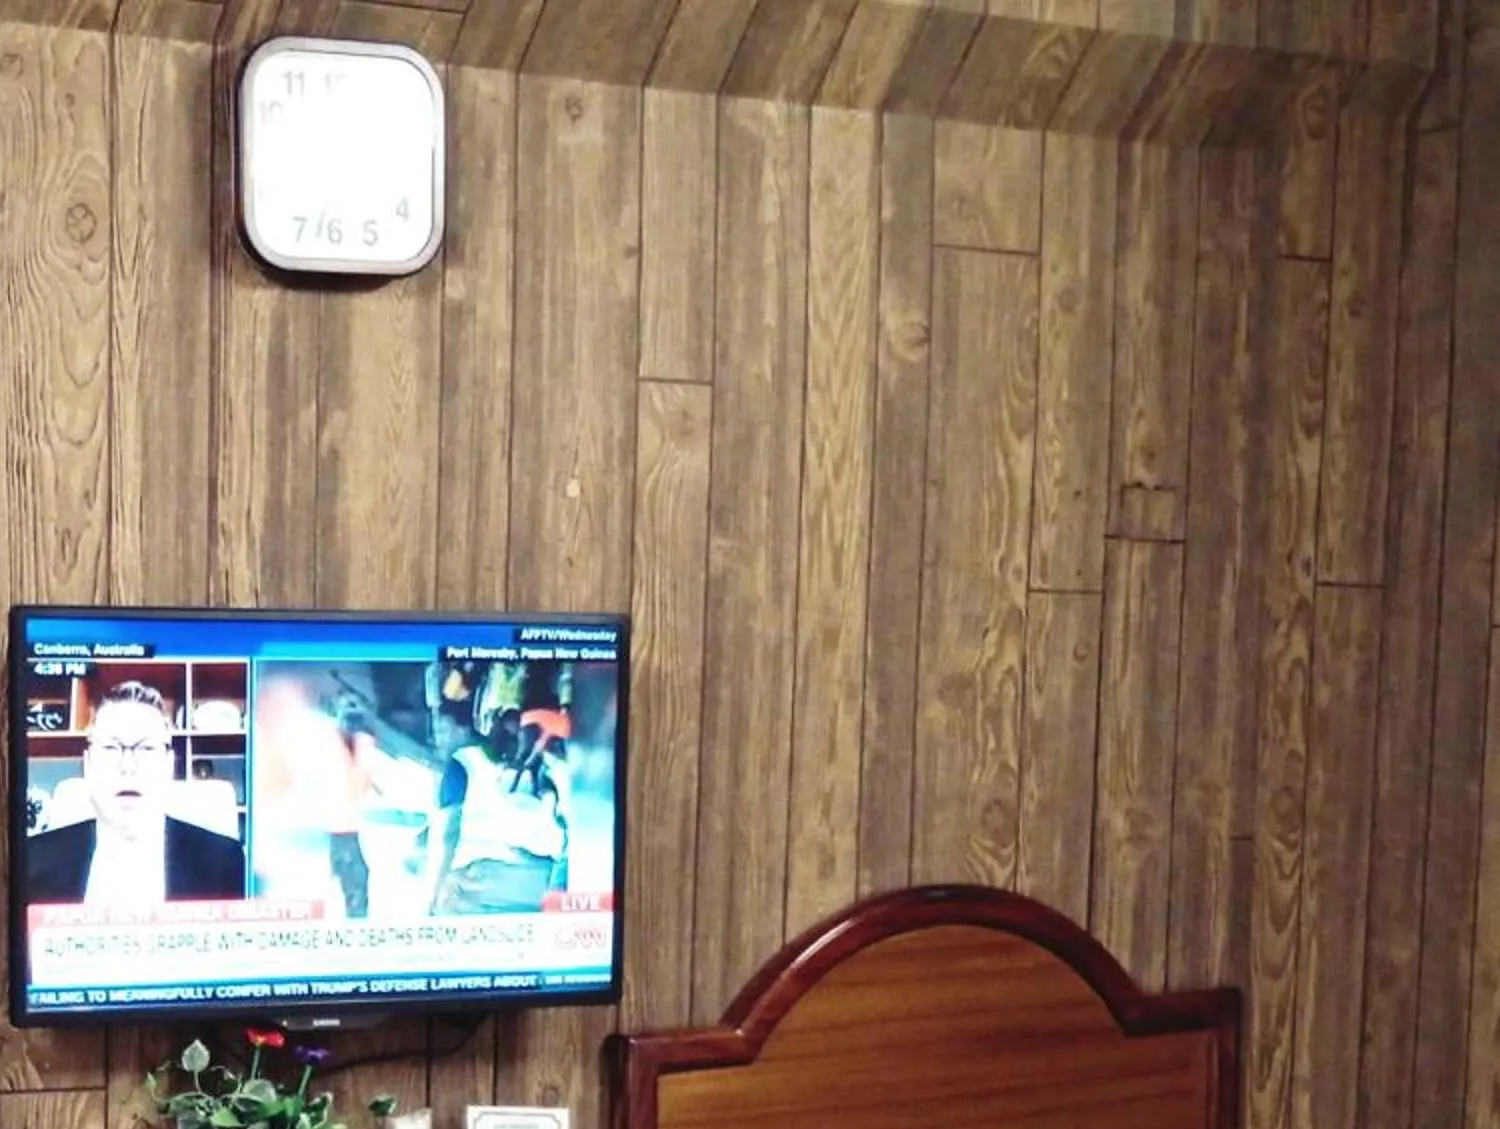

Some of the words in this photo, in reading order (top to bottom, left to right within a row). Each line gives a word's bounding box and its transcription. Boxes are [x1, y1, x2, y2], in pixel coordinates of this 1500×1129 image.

[282, 70, 306, 97] 11
[394, 196, 411, 222] 4
[291, 215, 308, 244] 7
[326, 218, 344, 245] 6
[362, 219, 380, 248] 5
[561, 892, 601, 912] LIVE
[44, 934, 142, 958] AUTHORITIES
[257, 928, 320, 951] DAMAGE
[325, 928, 354, 948] AND
[358, 926, 414, 948] DEATHS
[417, 925, 458, 946] FROM
[87, 989, 108, 1005] TO
[216, 983, 271, 1000] CONFER
[273, 981, 309, 998] WITH
[370, 977, 428, 993] DEFENSE
[430, 976, 492, 992] LAWYERS
[494, 974, 537, 990] ABOUT
